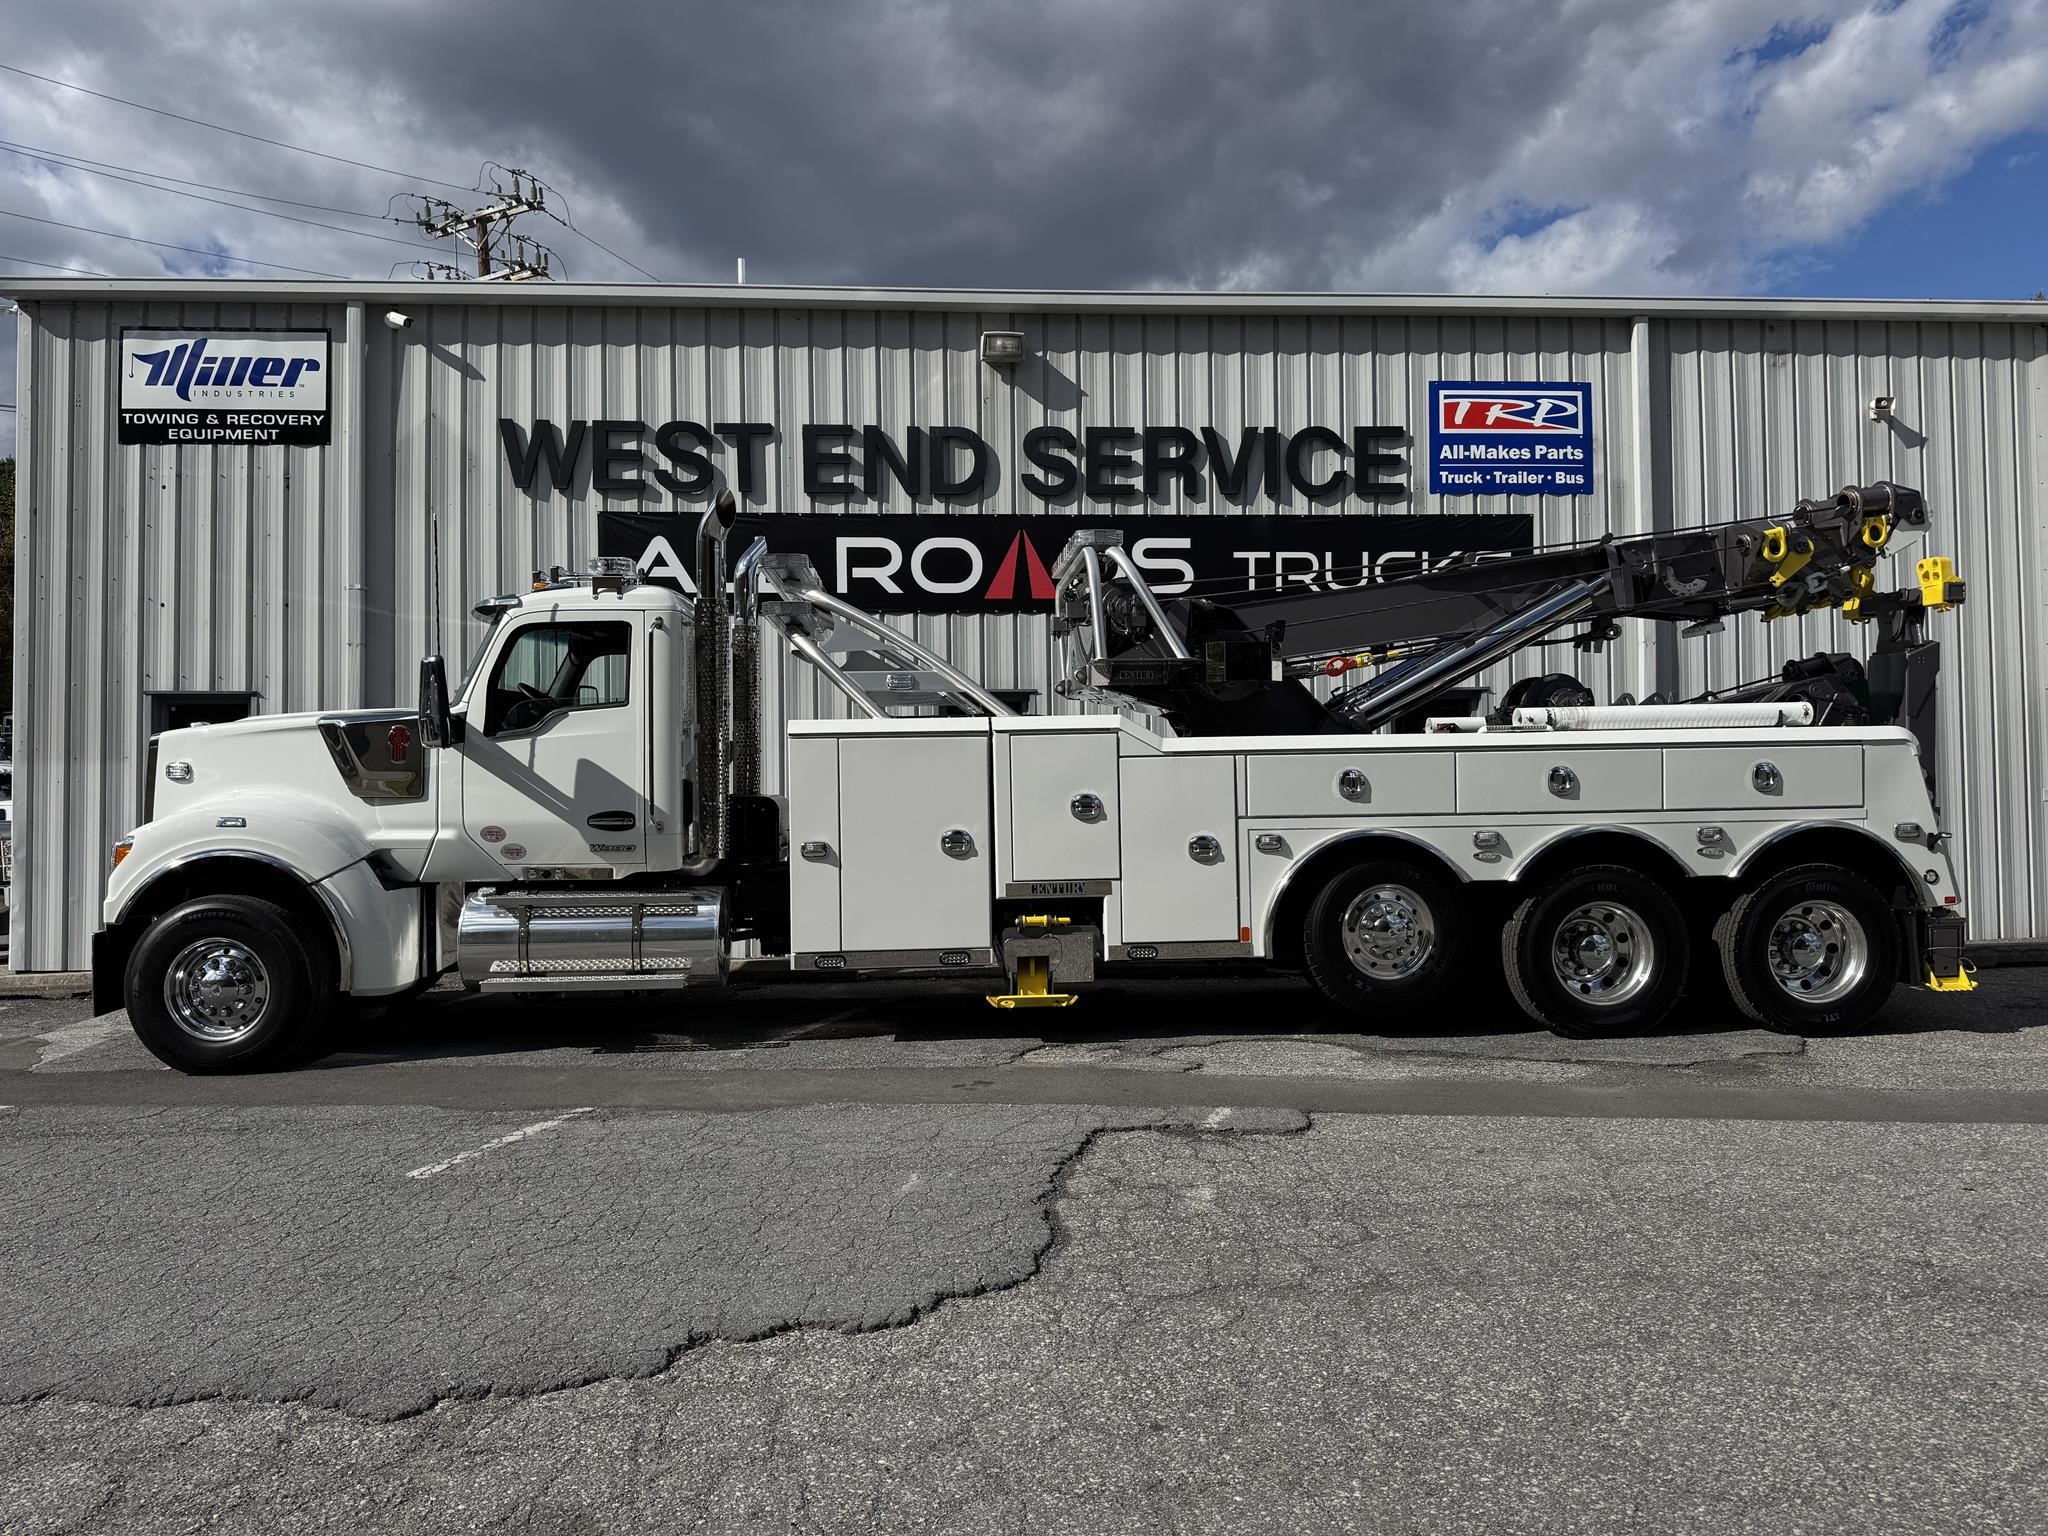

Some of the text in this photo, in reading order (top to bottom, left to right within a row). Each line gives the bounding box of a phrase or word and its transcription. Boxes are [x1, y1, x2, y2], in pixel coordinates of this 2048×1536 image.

[129, 338, 321, 402] Miller
[194, 390, 295, 398] INDUSTRIES
[122, 413, 324, 426] TOWING & RECOVERY
[1444, 398, 1578, 428] TRP
[168, 428, 280, 440] EQUIPMENT
[500, 418, 1405, 499] WEST END SERVICE
[1440, 445, 1584, 460] All-Makes Parts
[1440, 471, 1585, 484] Truck Trailer Bus
[836, 529, 1194, 599] ROAS
[1119, 669, 1155, 681] CENTURY
[1031, 882, 1087, 895] CENTURY
